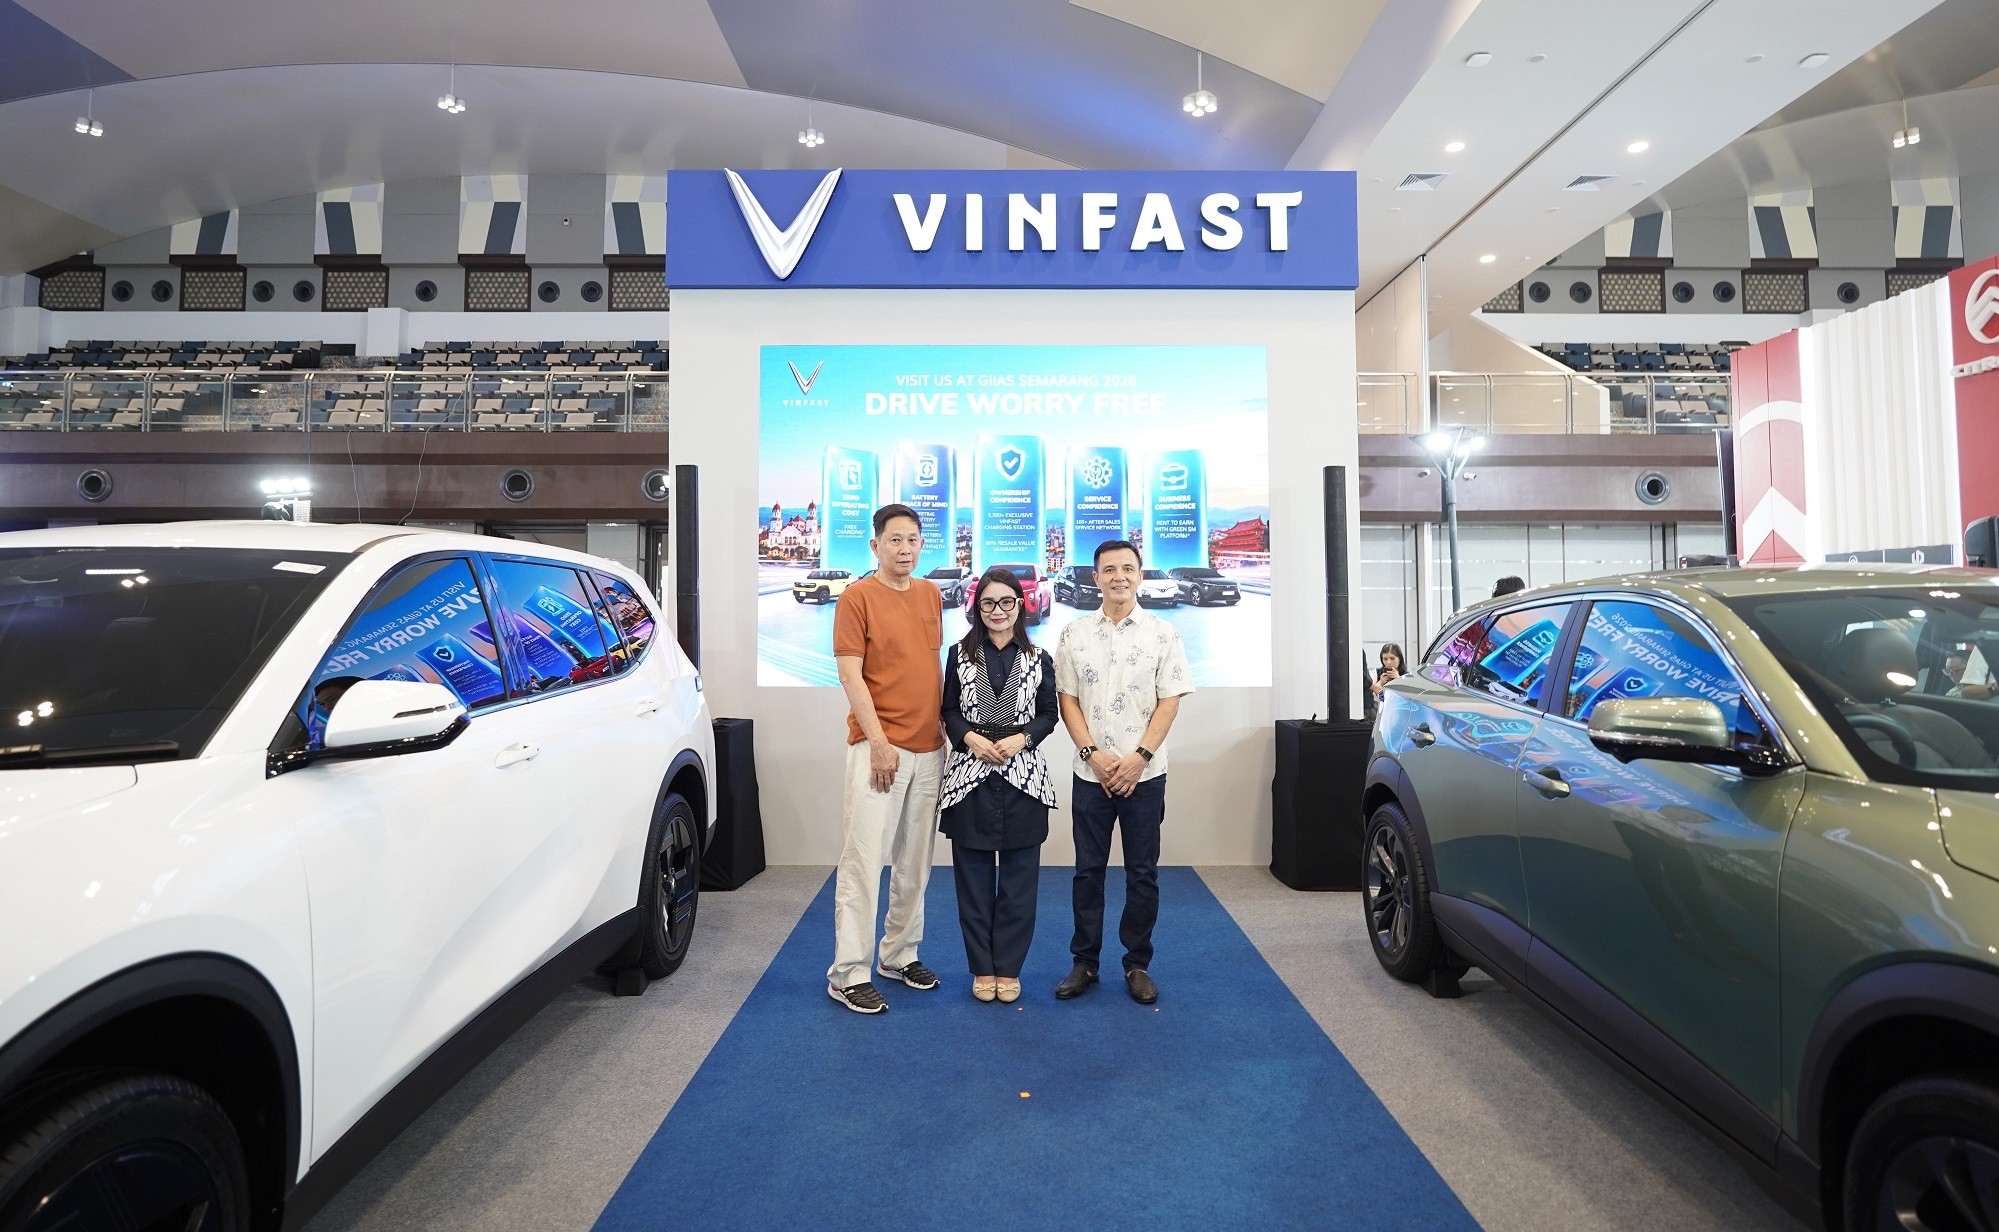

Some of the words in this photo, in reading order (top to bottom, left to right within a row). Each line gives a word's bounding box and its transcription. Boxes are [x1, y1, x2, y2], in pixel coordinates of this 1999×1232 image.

[893, 190, 1303, 252] VINFAST
[1950, 355, 1999, 378] CITR
[896, 375, 929, 386] VISIT
[934, 375, 952, 386] US
[956, 375, 974, 386] AT
[978, 375, 1015, 386] GIIAS
[1019, 375, 1098, 386] SEMARANG
[1103, 375, 1136, 386] 2026
[782, 399, 831, 407] VINFAST
[865, 392, 959, 416] DRIVE
[970, 392, 1085, 416] WORRY
[1094, 392, 1167, 416] FREE
[832, 501, 869, 509] OPERATING
